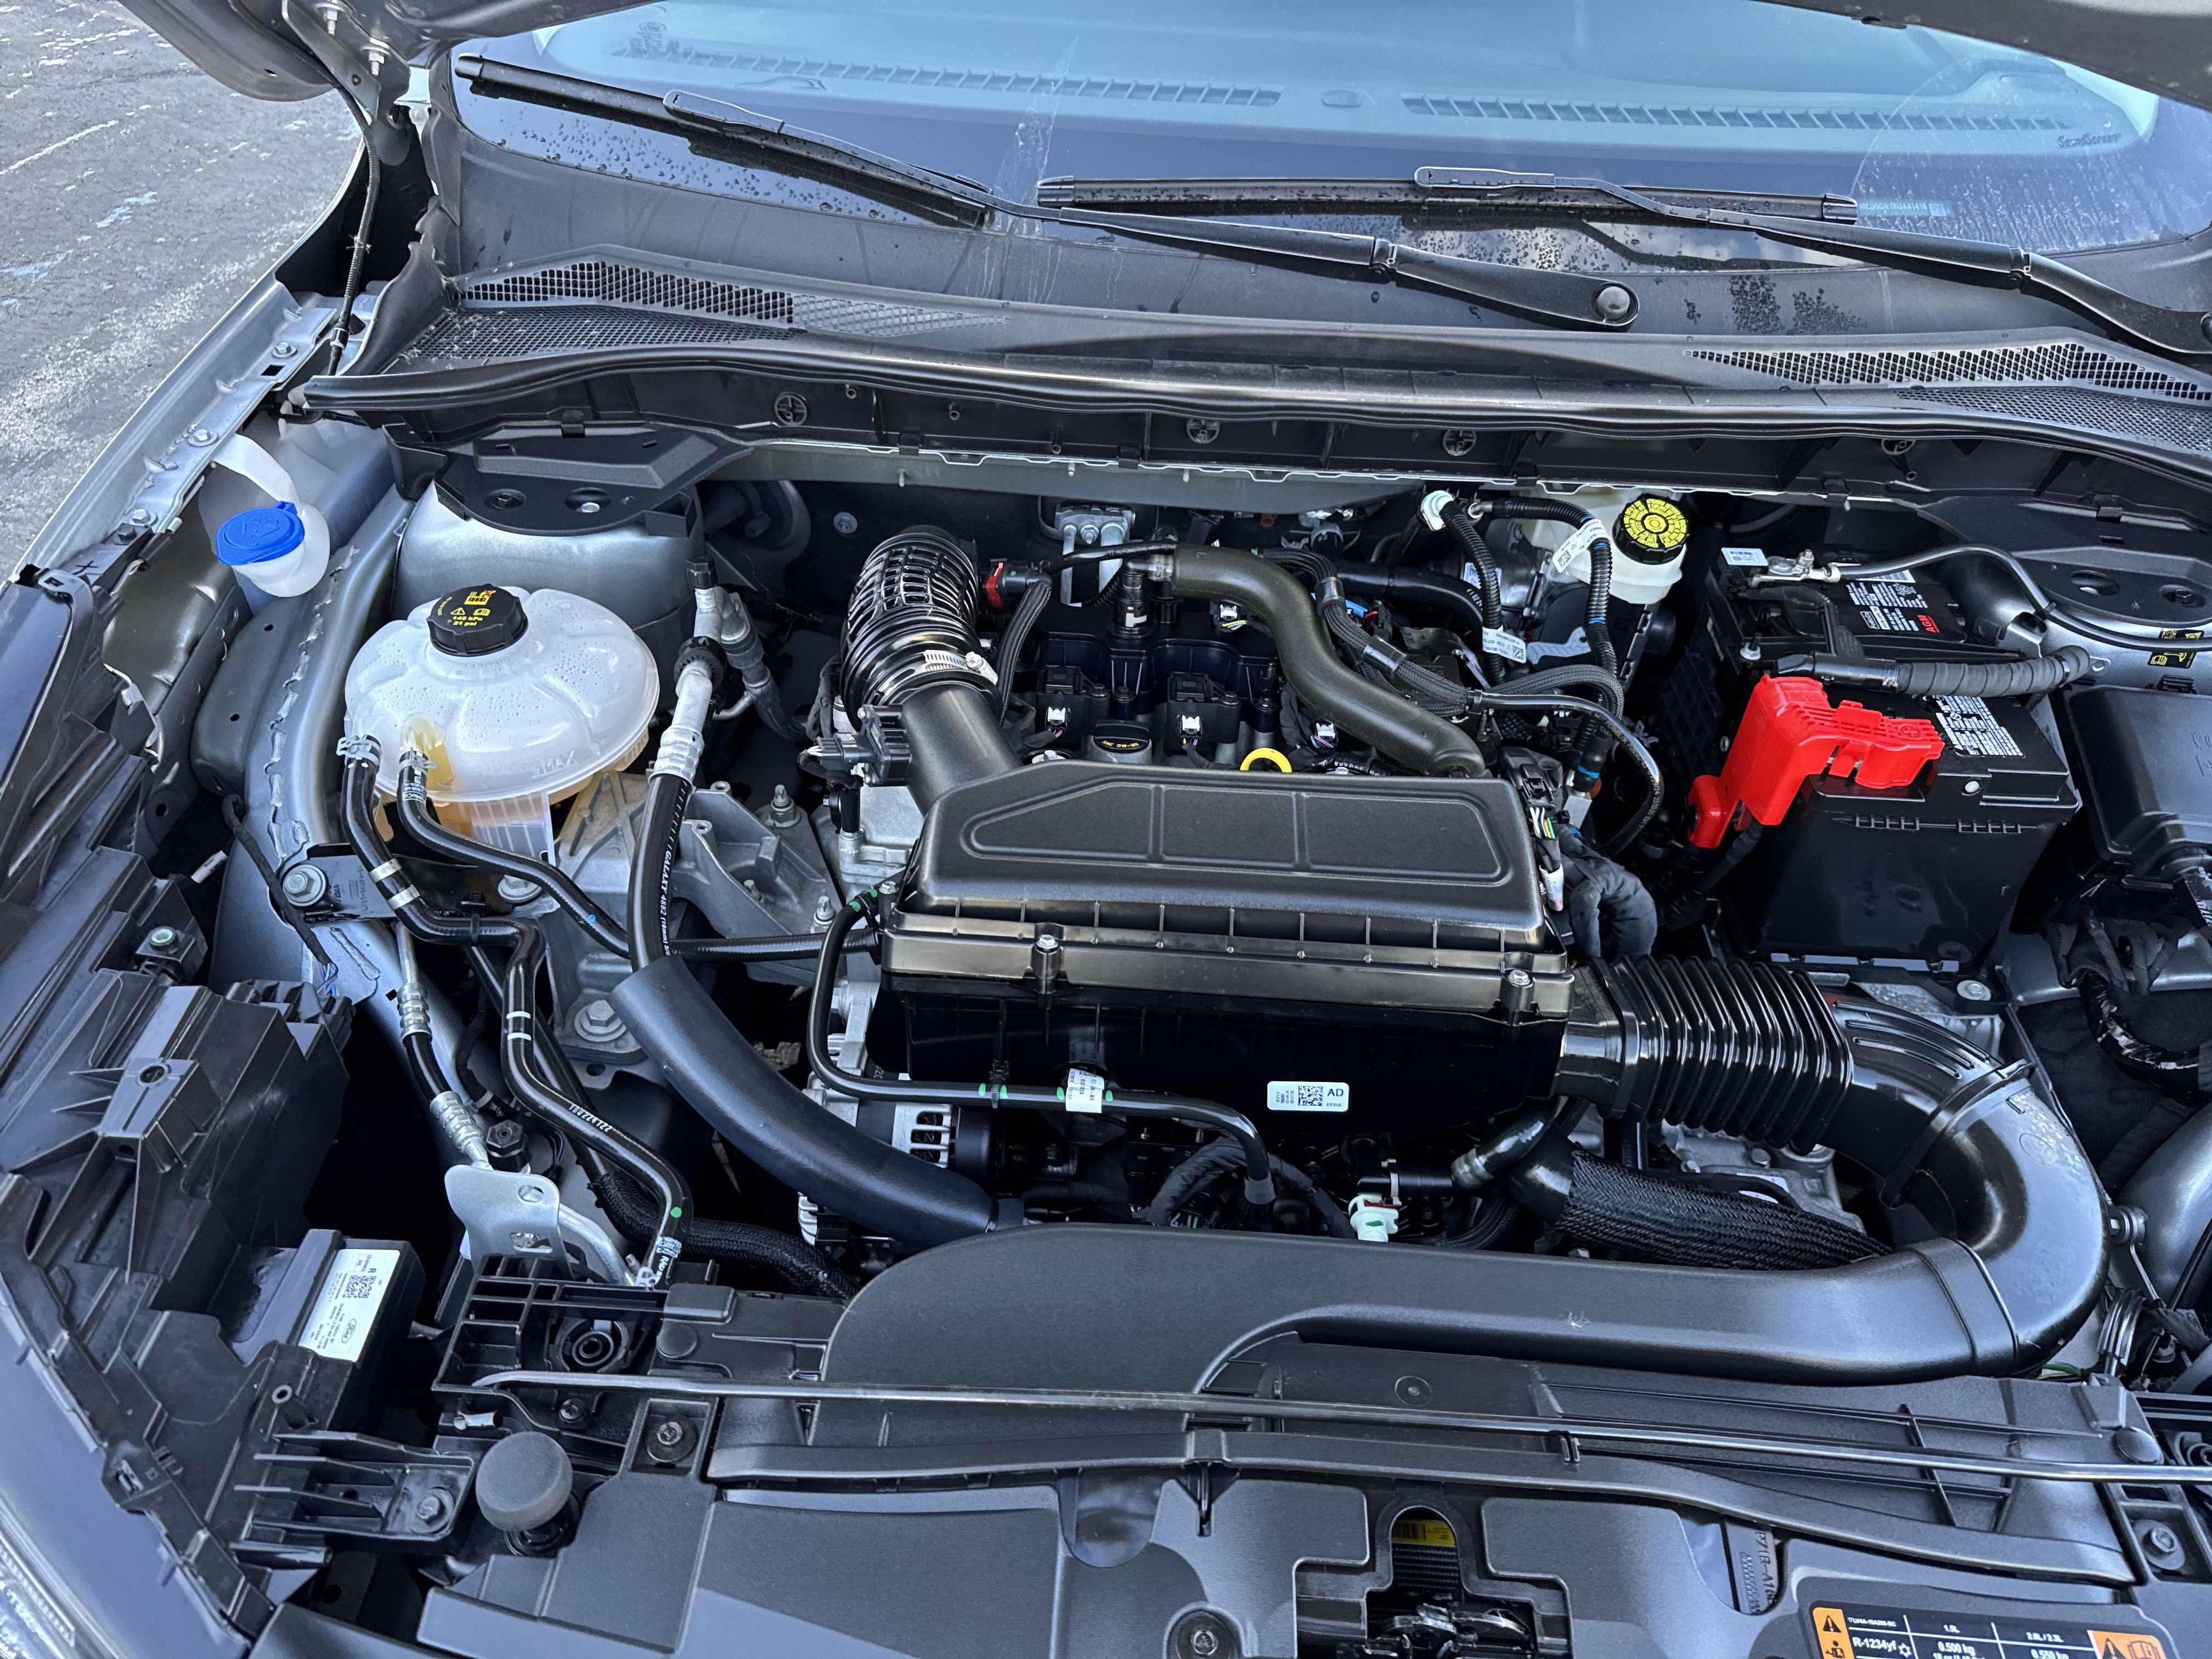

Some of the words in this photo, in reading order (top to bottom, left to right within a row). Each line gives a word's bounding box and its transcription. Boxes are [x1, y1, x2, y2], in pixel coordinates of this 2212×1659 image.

[661, 850, 672, 893] GALAXY
[1327, 1088, 1344, 1097] AD
[1852, 1637, 1897, 1652] R-1234yf
[1938, 1641, 1962, 1653] 0.500
[1962, 1644, 1976, 1657] kg
